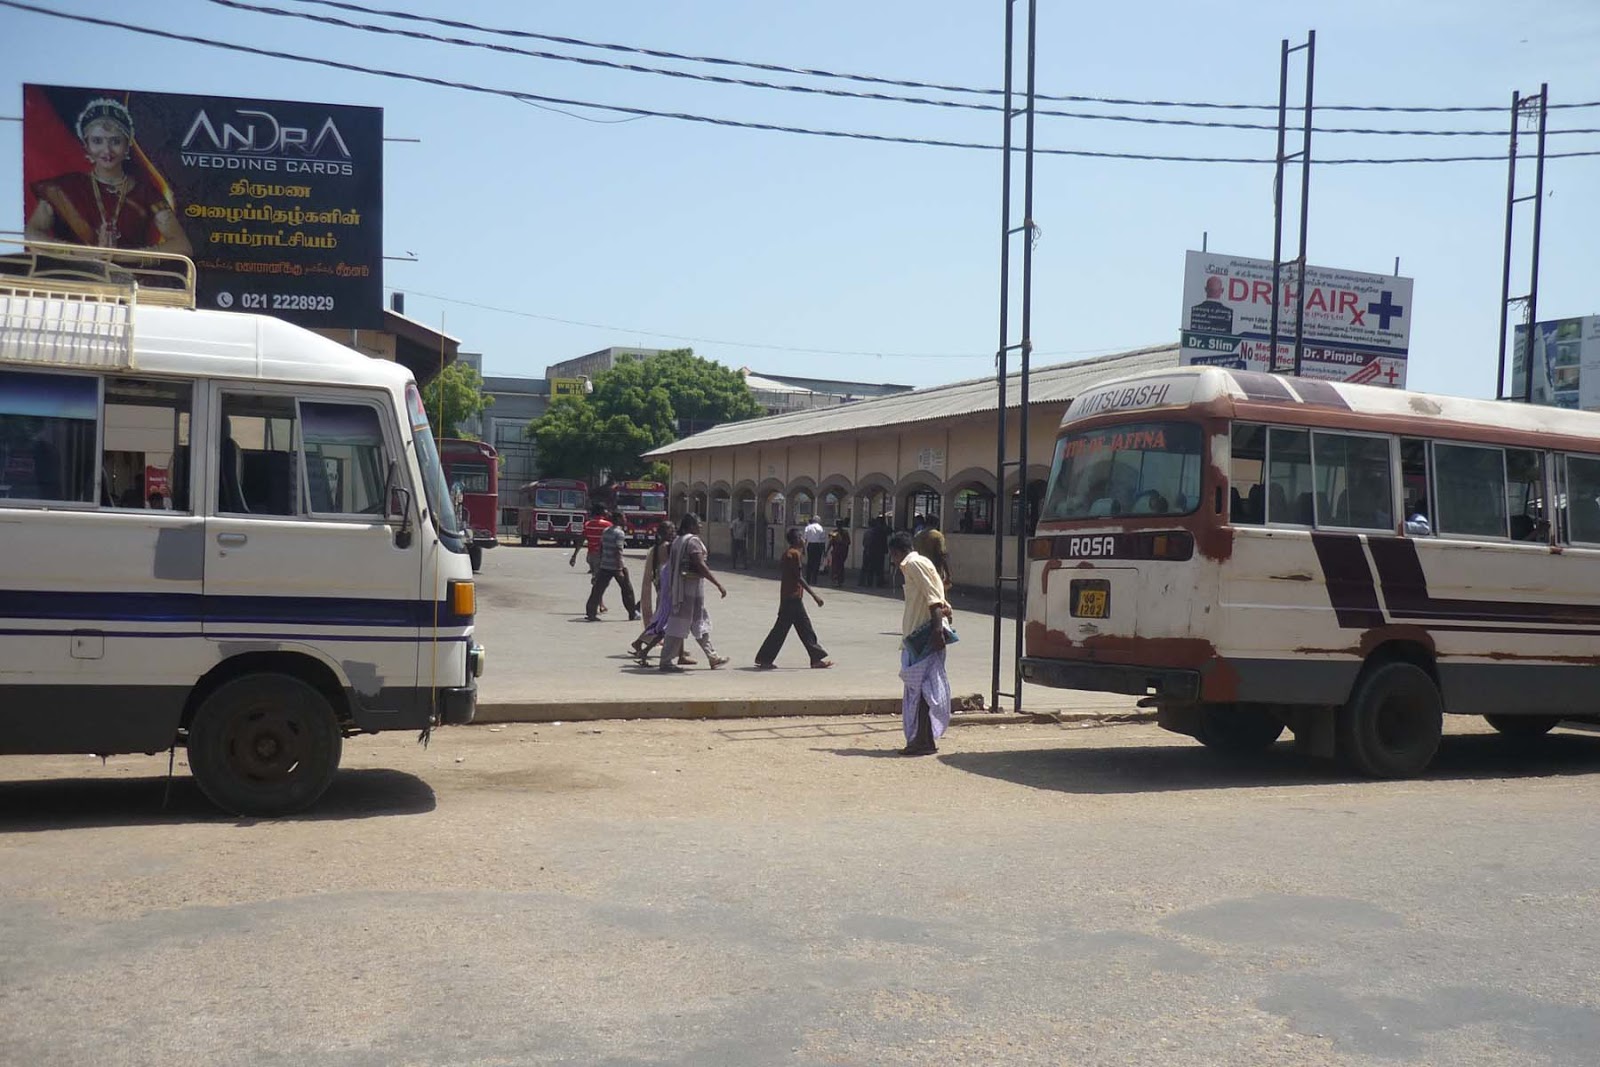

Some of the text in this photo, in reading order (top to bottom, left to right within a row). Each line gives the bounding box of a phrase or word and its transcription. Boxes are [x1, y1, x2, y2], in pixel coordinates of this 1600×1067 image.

[181, 155, 353, 176] WEDDING CARDS
[229, 179, 312, 198] திருமண
[185, 203, 361, 226] அழைப்பிதழ்களின்
[210, 228, 338, 249] சாம்ராட்சியம்
[242, 293, 334, 311] 021 2228929
[1189, 337, 1233, 351] Dr. Slim
[1240, 341, 1254, 360] No
[1303, 347, 1319, 359] Dr.
[1323, 350, 1363, 364] Pimple
[1077, 383, 1170, 415] MITSUBISHI
[1070, 537, 1115, 556] ROSA
